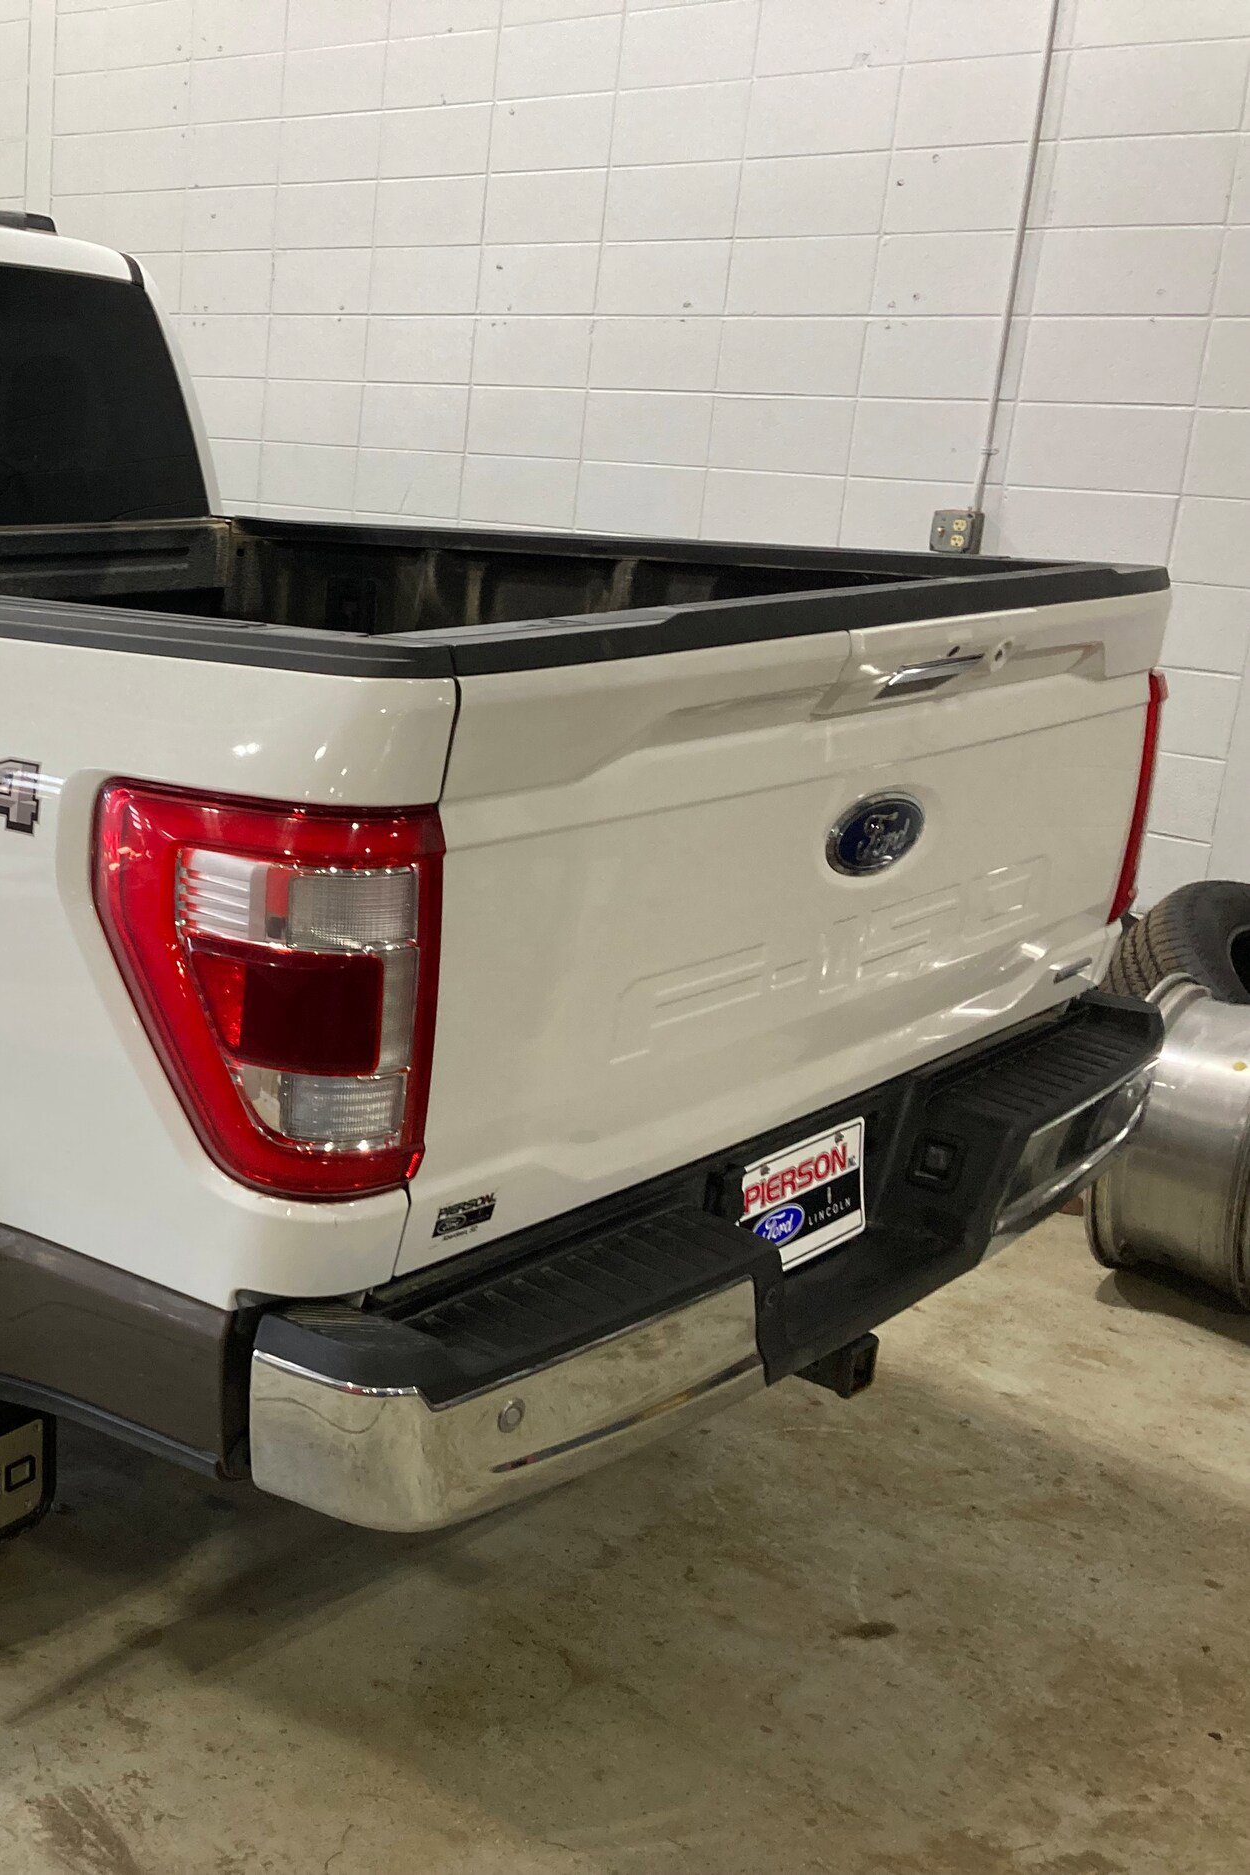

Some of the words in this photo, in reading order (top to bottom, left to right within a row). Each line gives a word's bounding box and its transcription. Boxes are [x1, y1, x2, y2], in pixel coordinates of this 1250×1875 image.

[743, 1143, 848, 1215] PIERSON
[437, 1192, 494, 1220] PIERSON
[808, 1196, 852, 1226] LINCOLN
[761, 1211, 795, 1240] Ford
